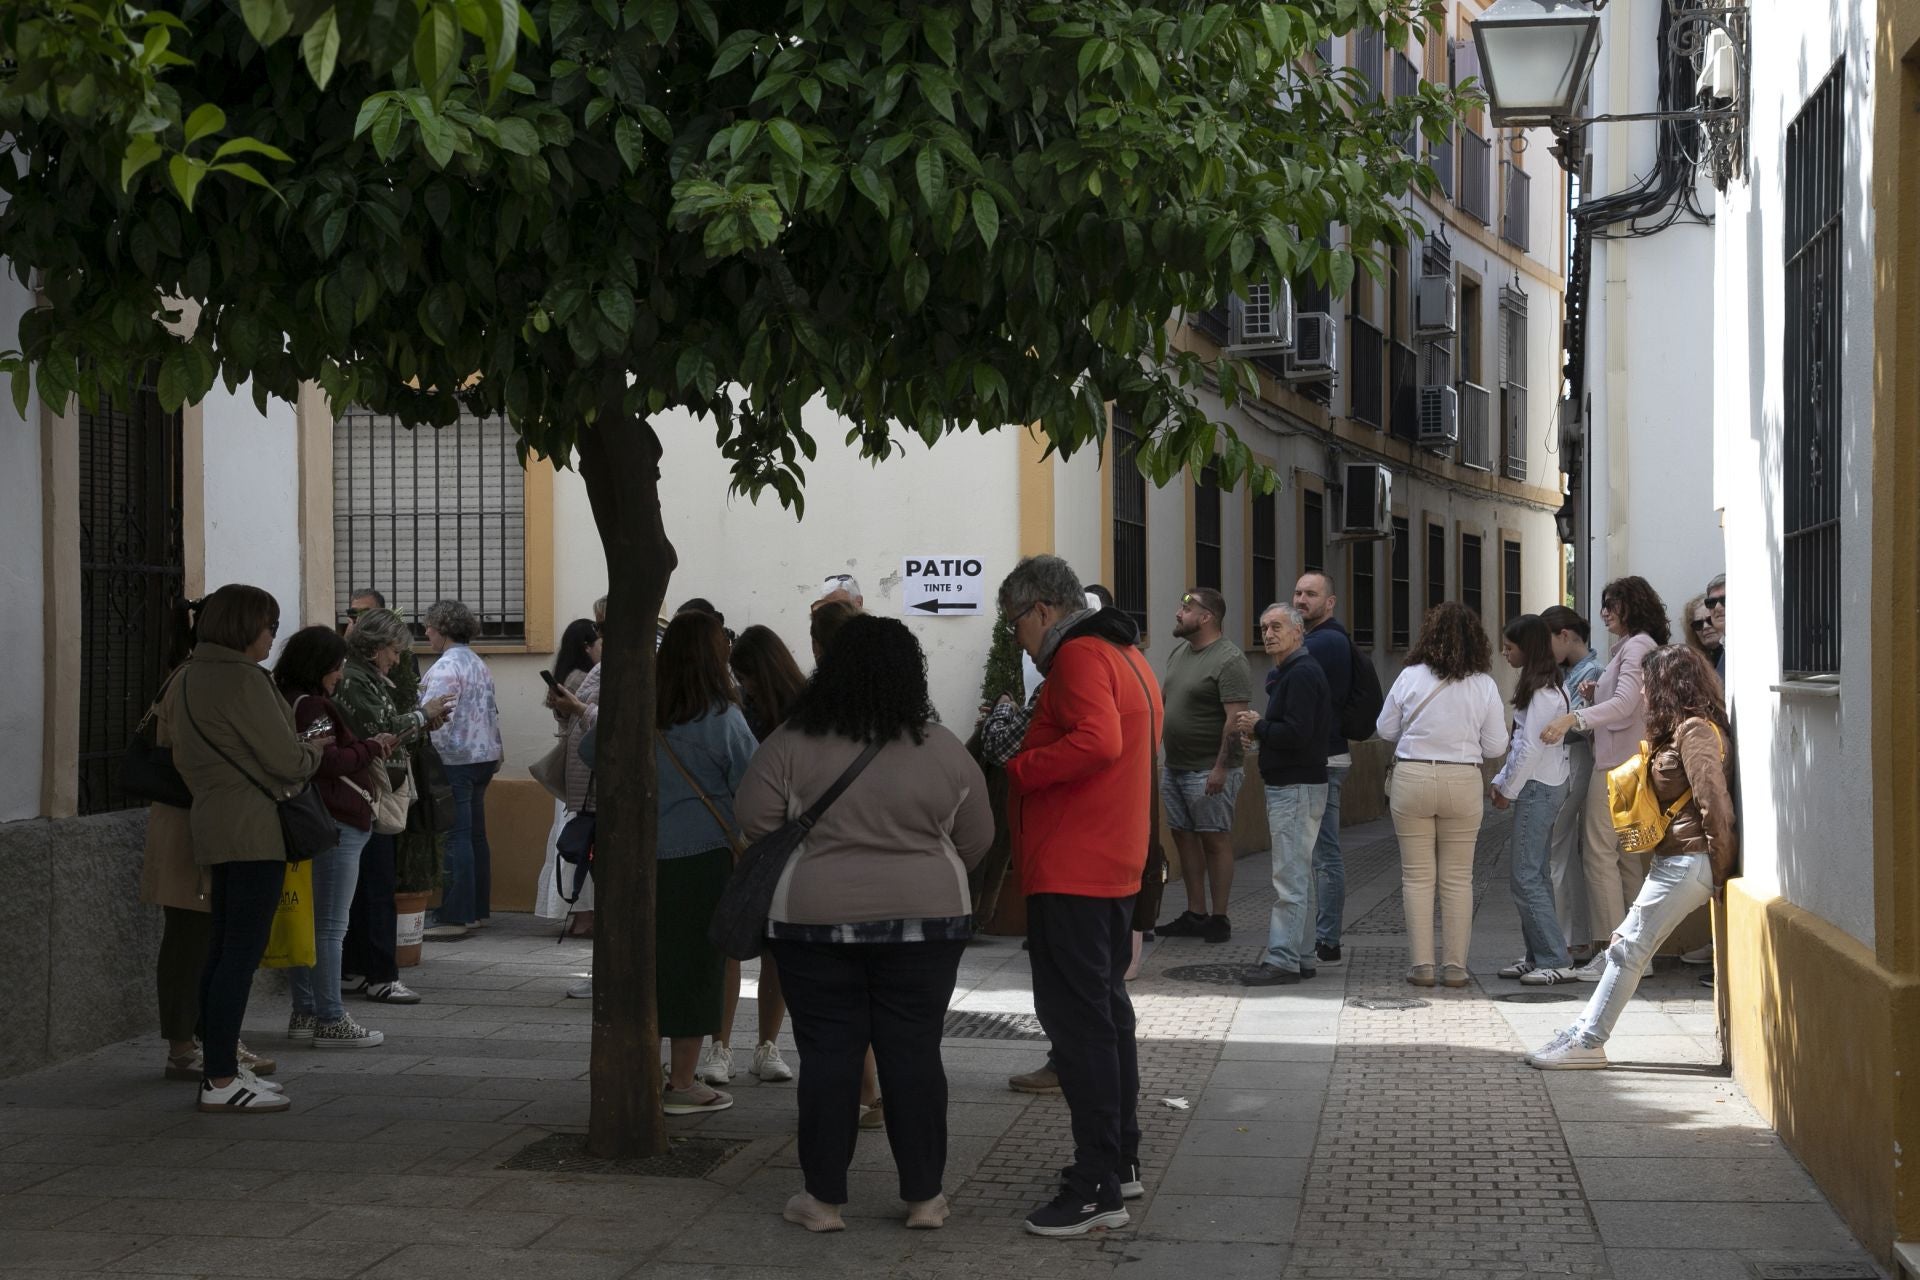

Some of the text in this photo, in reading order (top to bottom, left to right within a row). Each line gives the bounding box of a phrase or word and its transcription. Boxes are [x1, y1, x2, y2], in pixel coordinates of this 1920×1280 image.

[906, 559, 982, 577] PATIO
[923, 583, 963, 592] TINTE 9
